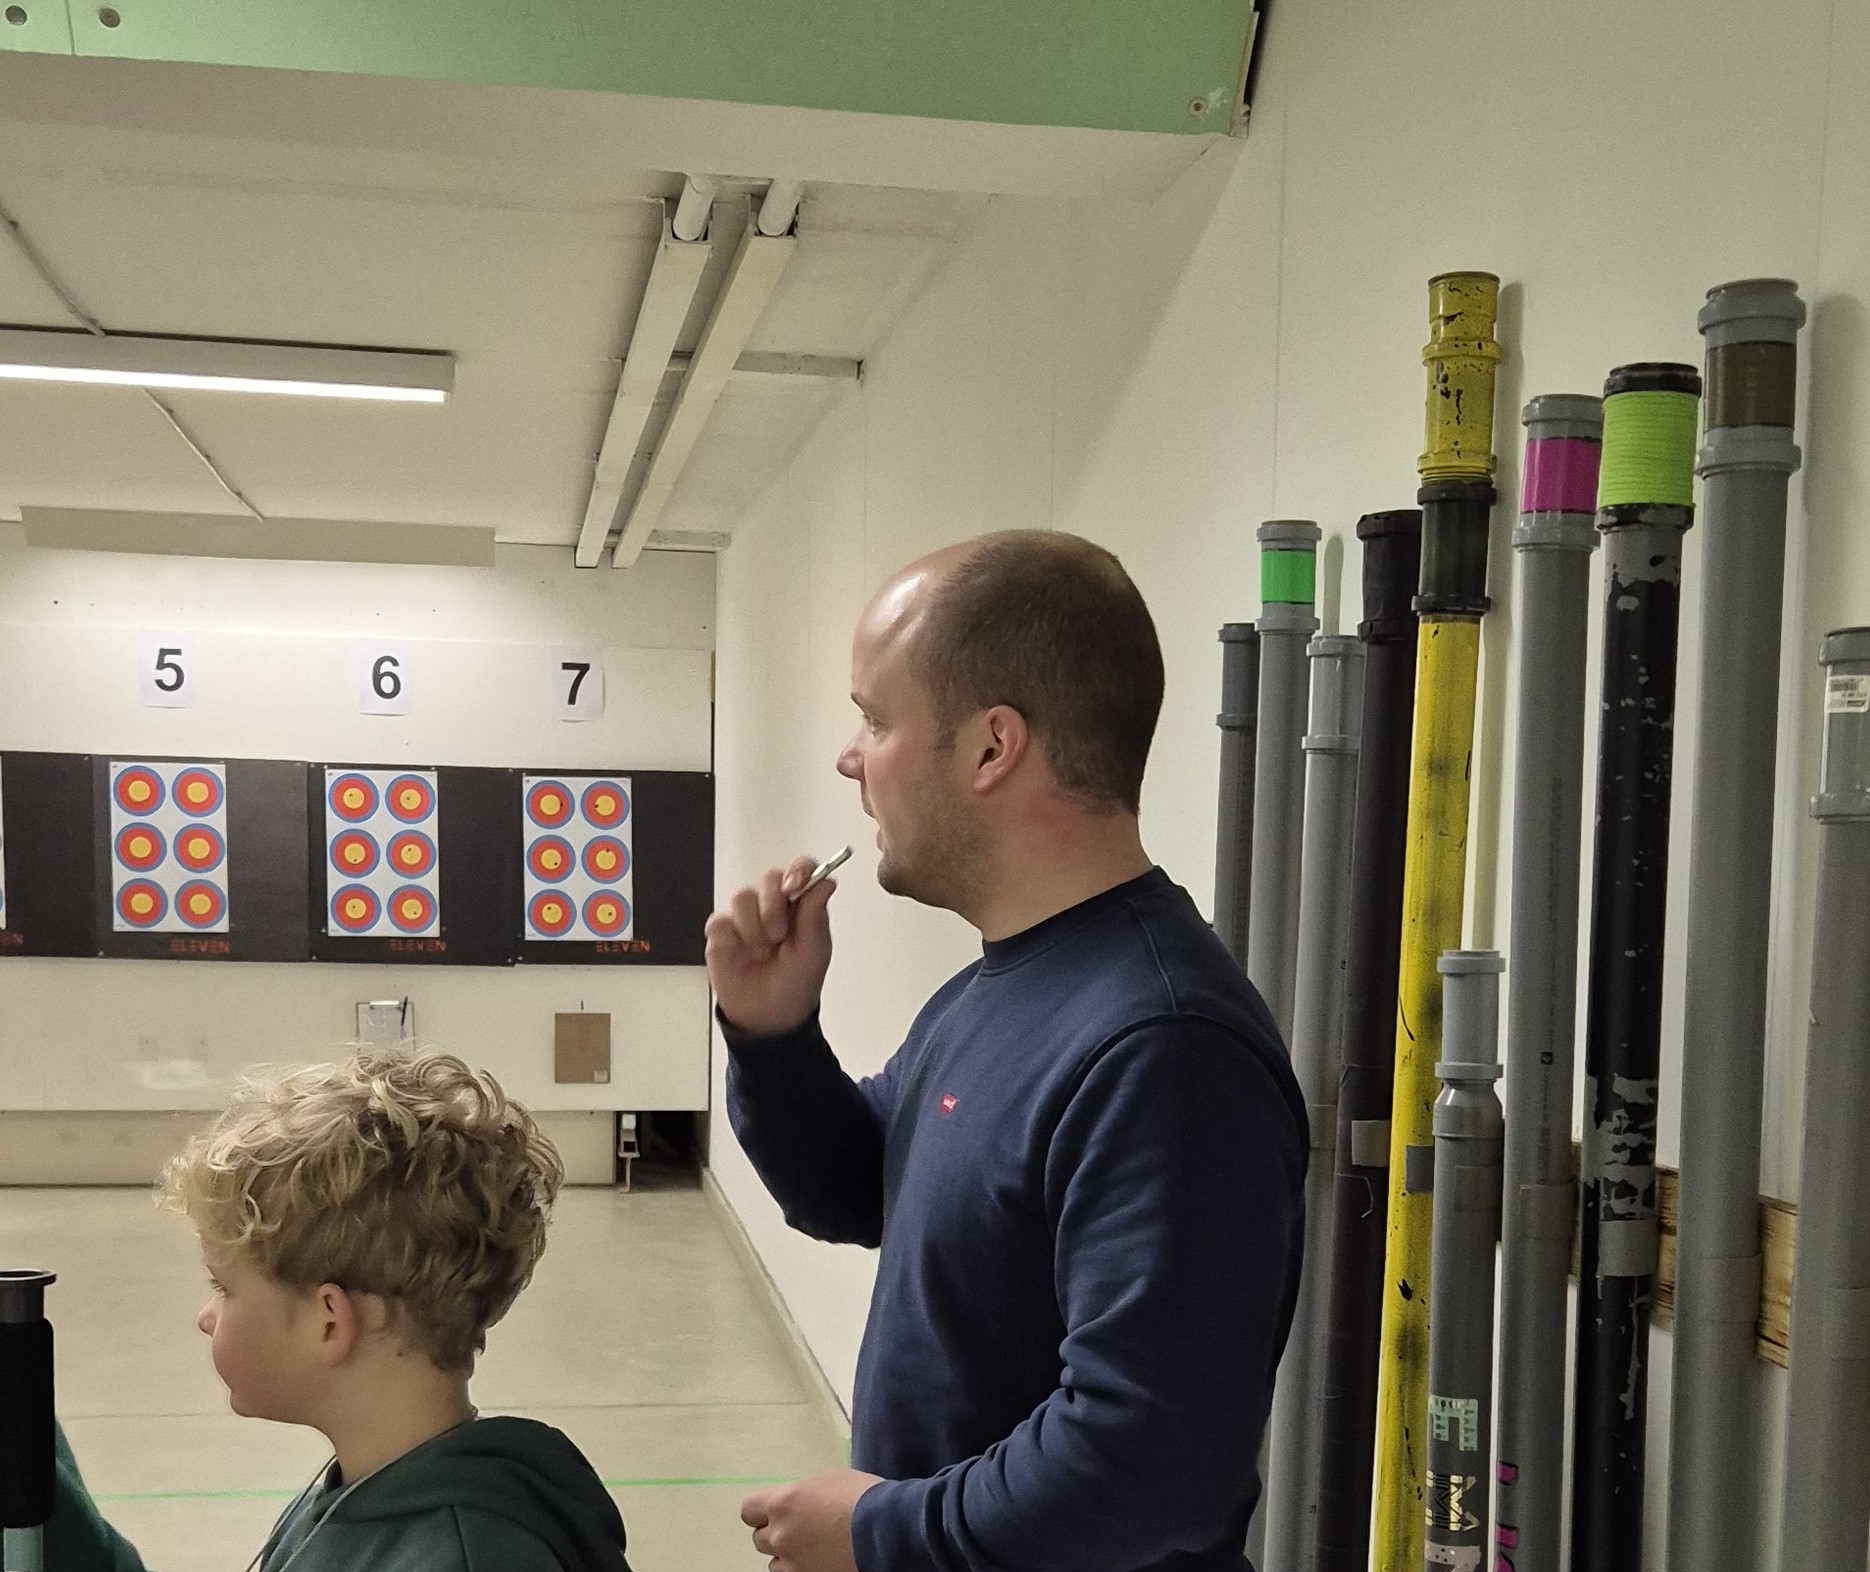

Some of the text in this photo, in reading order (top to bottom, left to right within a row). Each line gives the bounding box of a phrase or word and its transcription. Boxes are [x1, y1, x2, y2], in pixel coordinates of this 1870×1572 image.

[156, 648, 184, 692] 5
[372, 655, 402, 699] 6
[561, 662, 591, 706] 7
[388, 939, 447, 952] ELEVEN
[595, 940, 650, 952] ELEVEN
